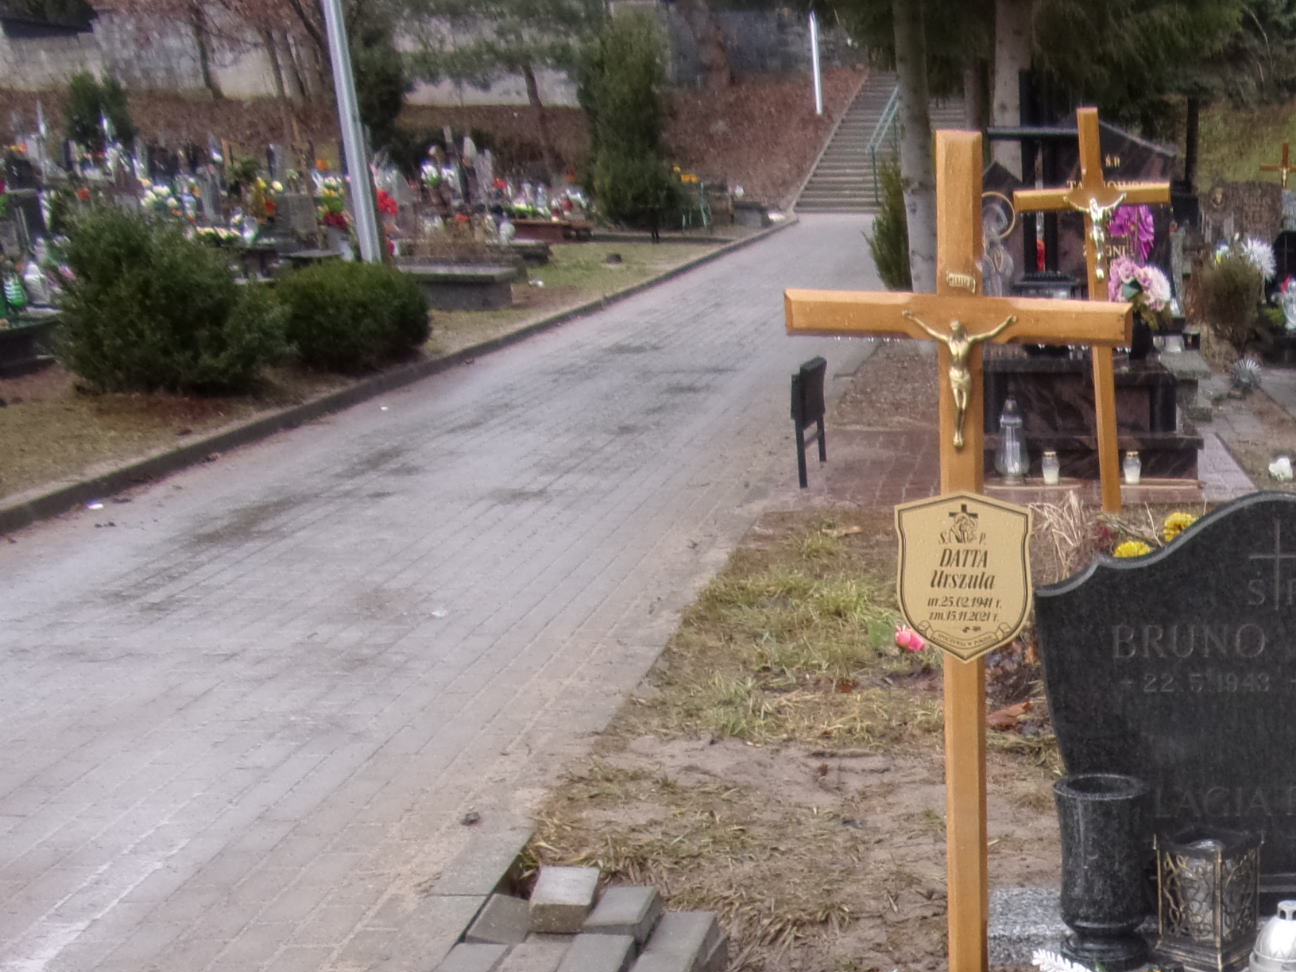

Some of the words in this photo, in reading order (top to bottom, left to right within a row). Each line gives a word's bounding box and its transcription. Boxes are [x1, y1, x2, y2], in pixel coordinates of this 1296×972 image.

[939, 547, 989, 569] DATTA
[929, 569, 996, 591] Urszula
[1111, 622, 1267, 660] BRUNO
[1154, 786, 1270, 818] LAGIA
